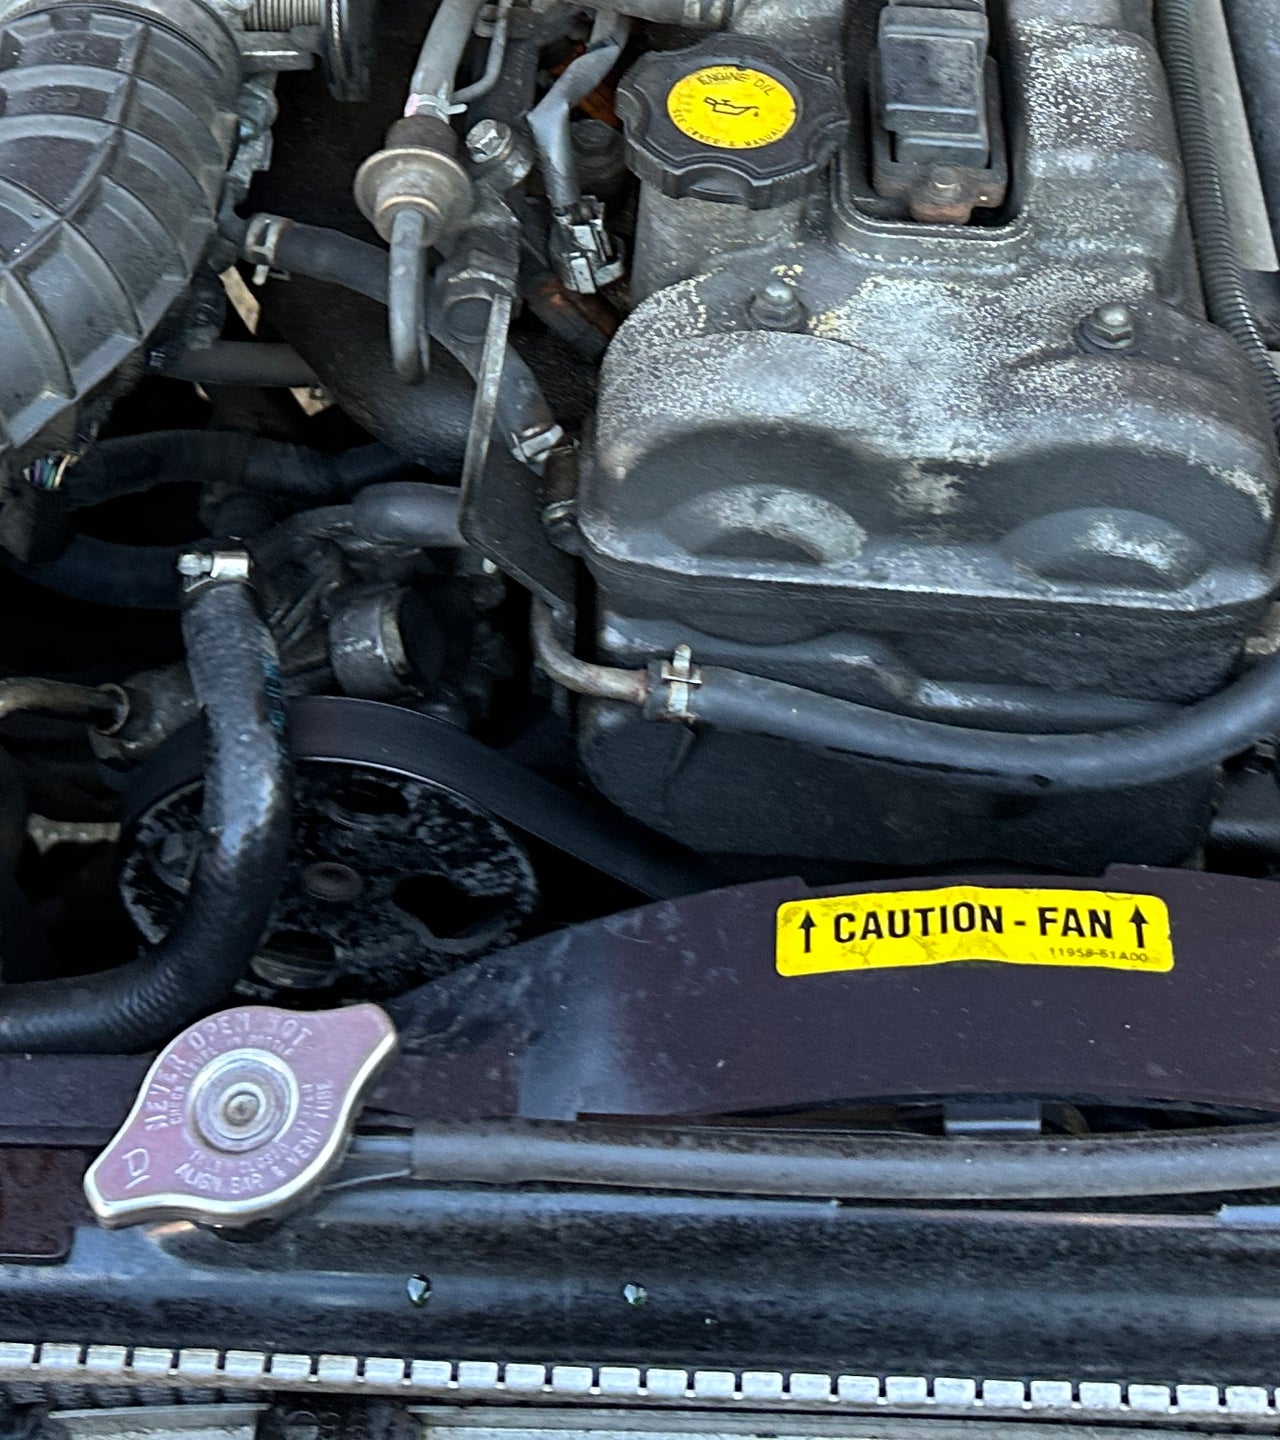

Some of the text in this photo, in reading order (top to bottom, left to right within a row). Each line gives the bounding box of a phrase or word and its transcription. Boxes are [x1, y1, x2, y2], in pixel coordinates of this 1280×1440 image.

[696, 71, 777, 97] ENGINE OIL
[743, 127, 783, 147] MANUAL
[834, 901, 1004, 944] CAUTION
[1037, 906, 1113, 940] FAN
[145, 1053, 188, 1132] NEVER
[186, 1012, 251, 1051] OPEN
[230, 1172, 265, 1194] EAR
[314, 1079, 334, 1119] TUBE
